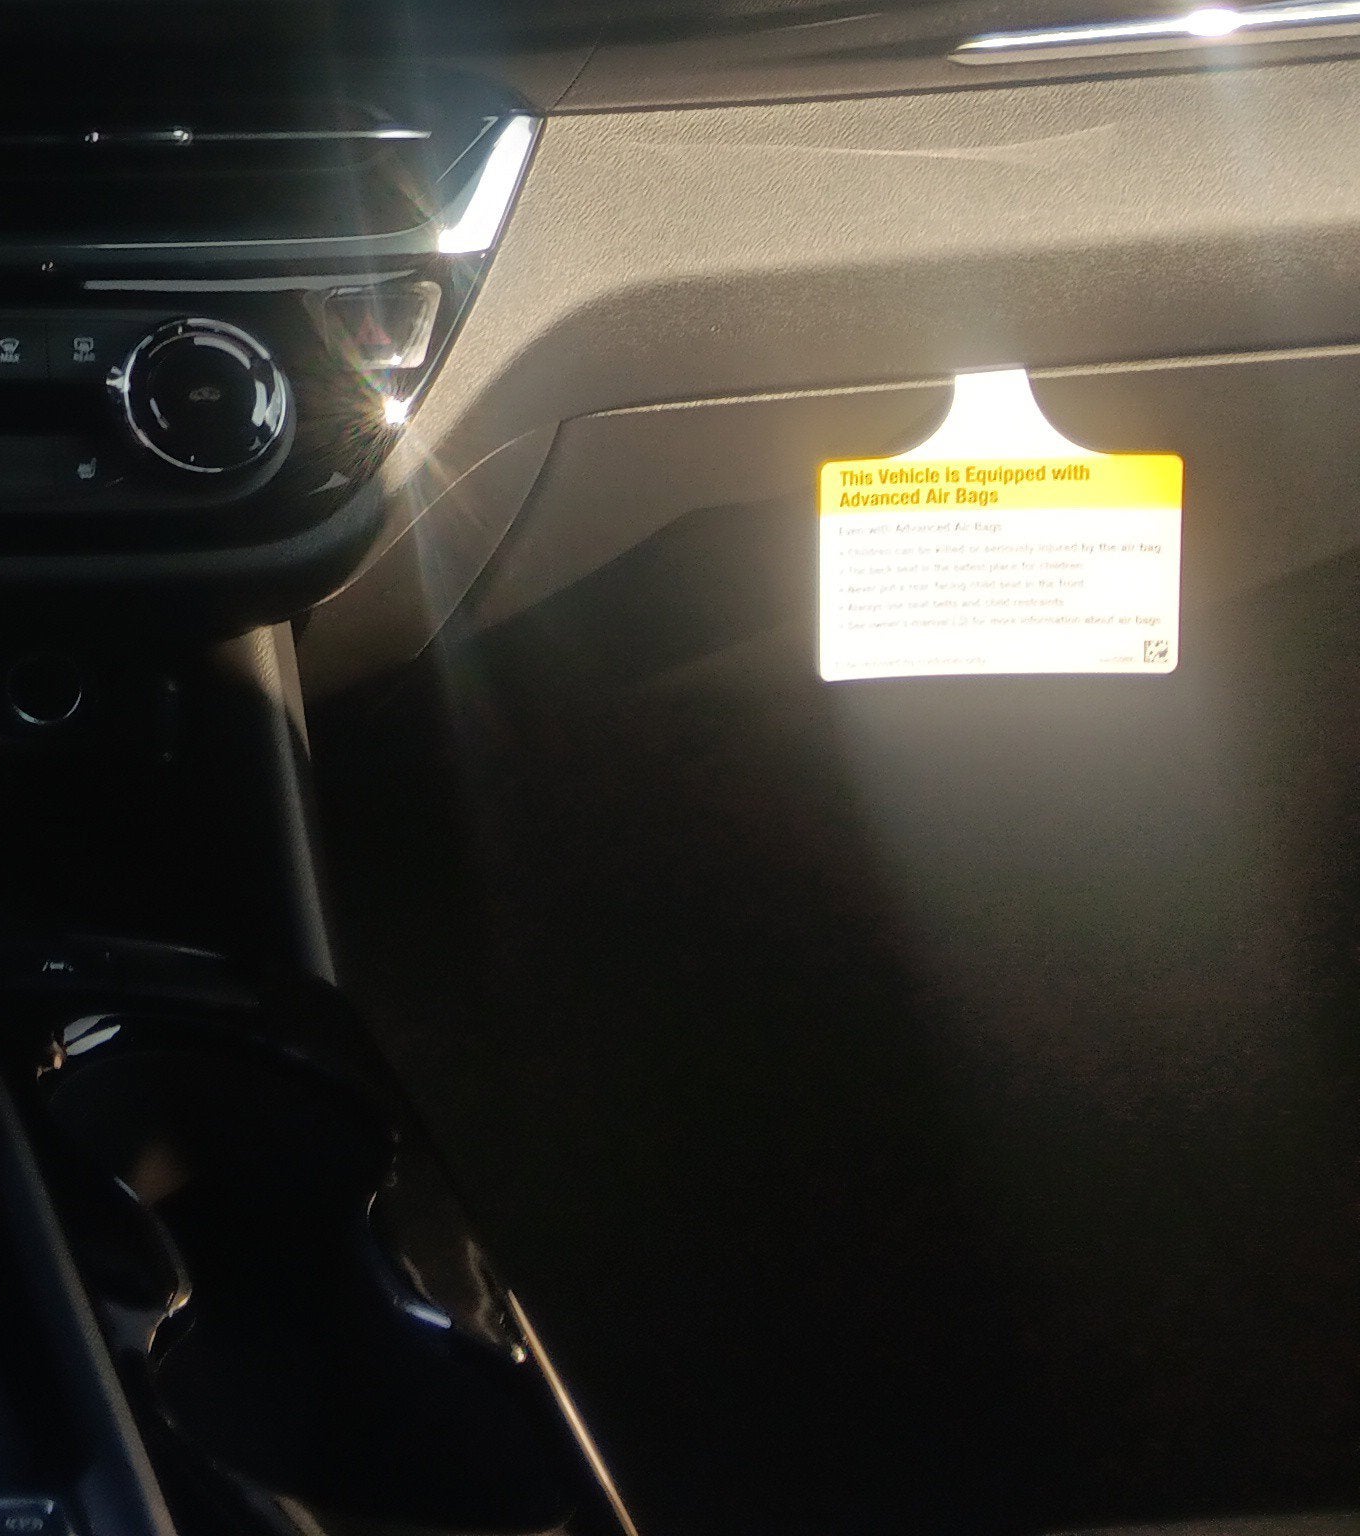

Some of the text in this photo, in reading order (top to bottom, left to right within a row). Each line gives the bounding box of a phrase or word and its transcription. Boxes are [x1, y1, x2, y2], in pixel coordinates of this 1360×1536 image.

[840, 470, 873, 487] This
[878, 467, 940, 485] Vehicle
[965, 465, 1046, 486] Equipped
[1051, 464, 1091, 481] with
[840, 487, 999, 508] Advanced Air Bags
